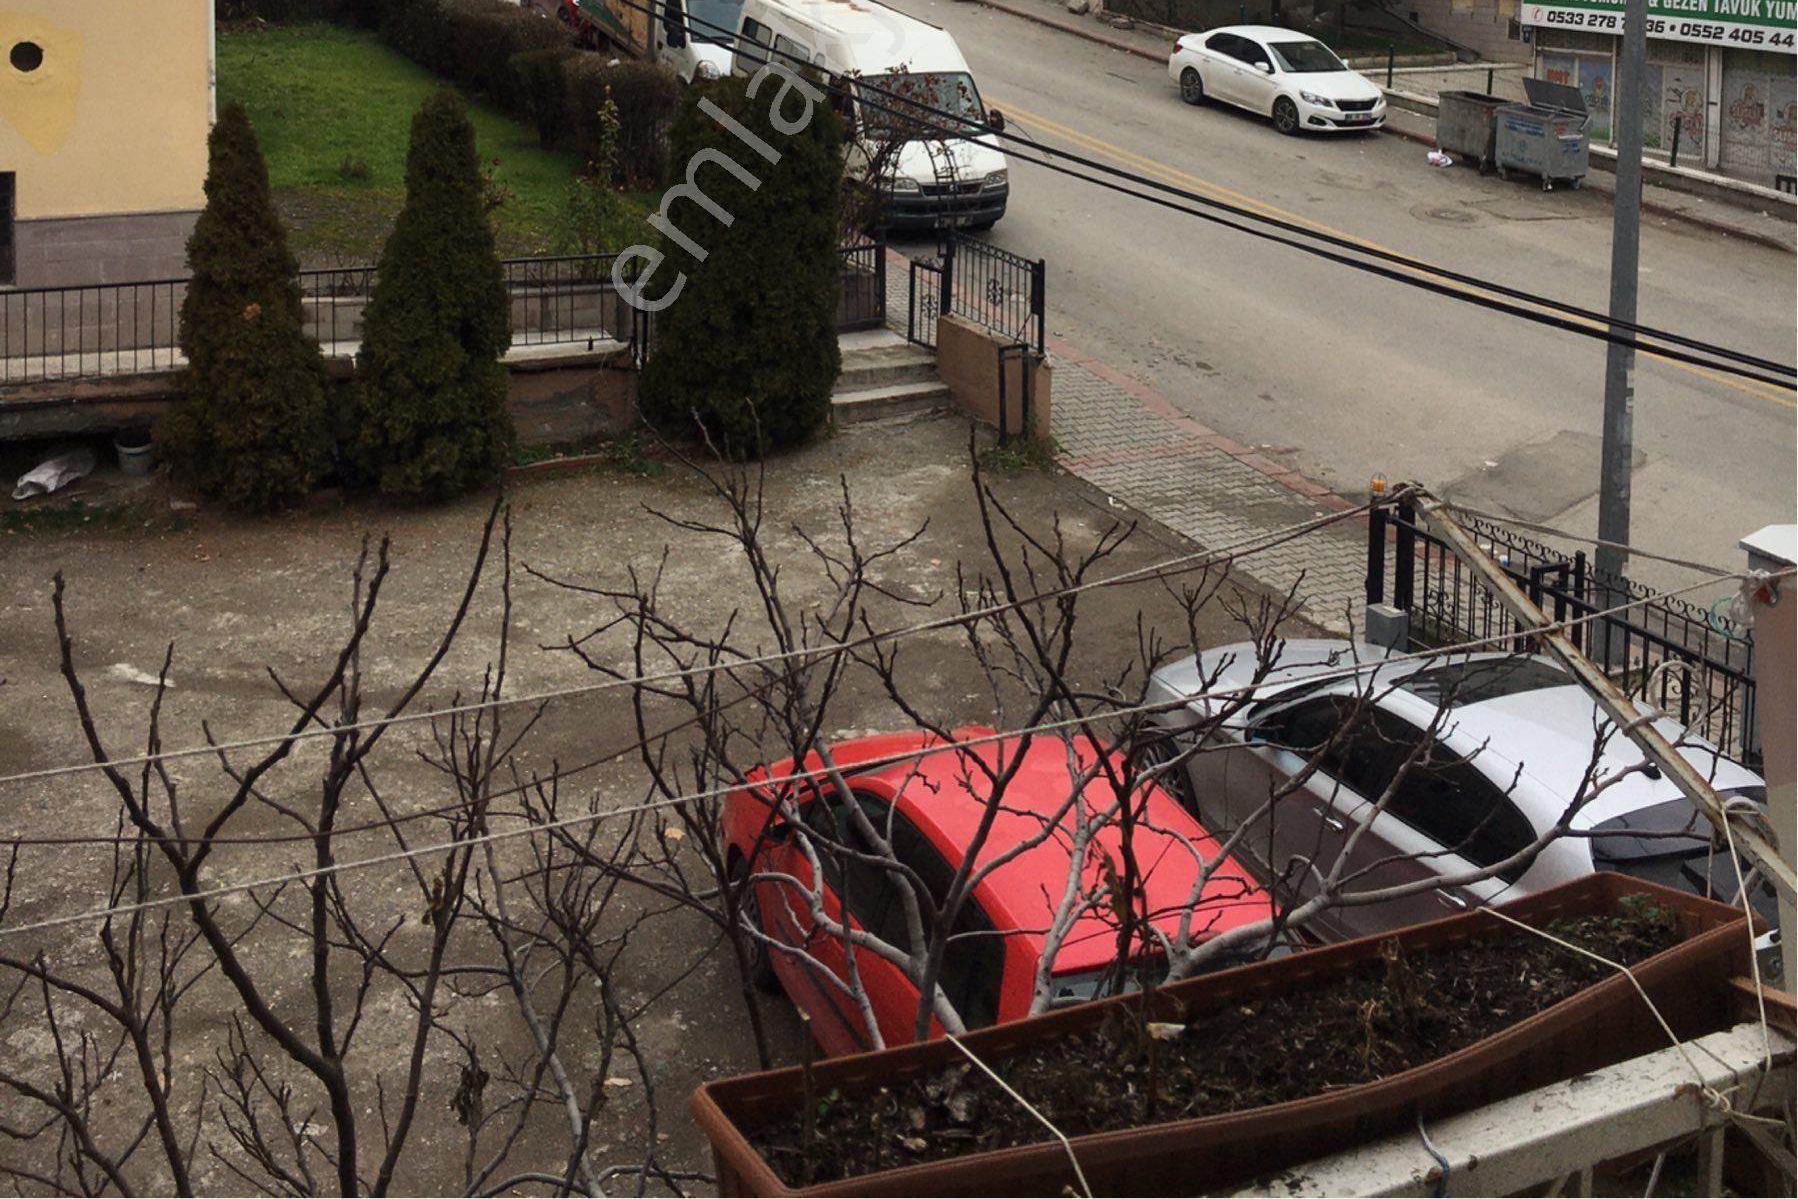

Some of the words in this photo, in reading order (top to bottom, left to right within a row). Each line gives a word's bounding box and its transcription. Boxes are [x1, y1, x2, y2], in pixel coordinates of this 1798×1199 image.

[1546, 10, 1585, 26] 0533
[1587, 14, 1617, 29] 278
[1680, 22, 1725, 41] 0552
[1728, 28, 1765, 45] 405
[1768, 32, 1795, 48] 44
